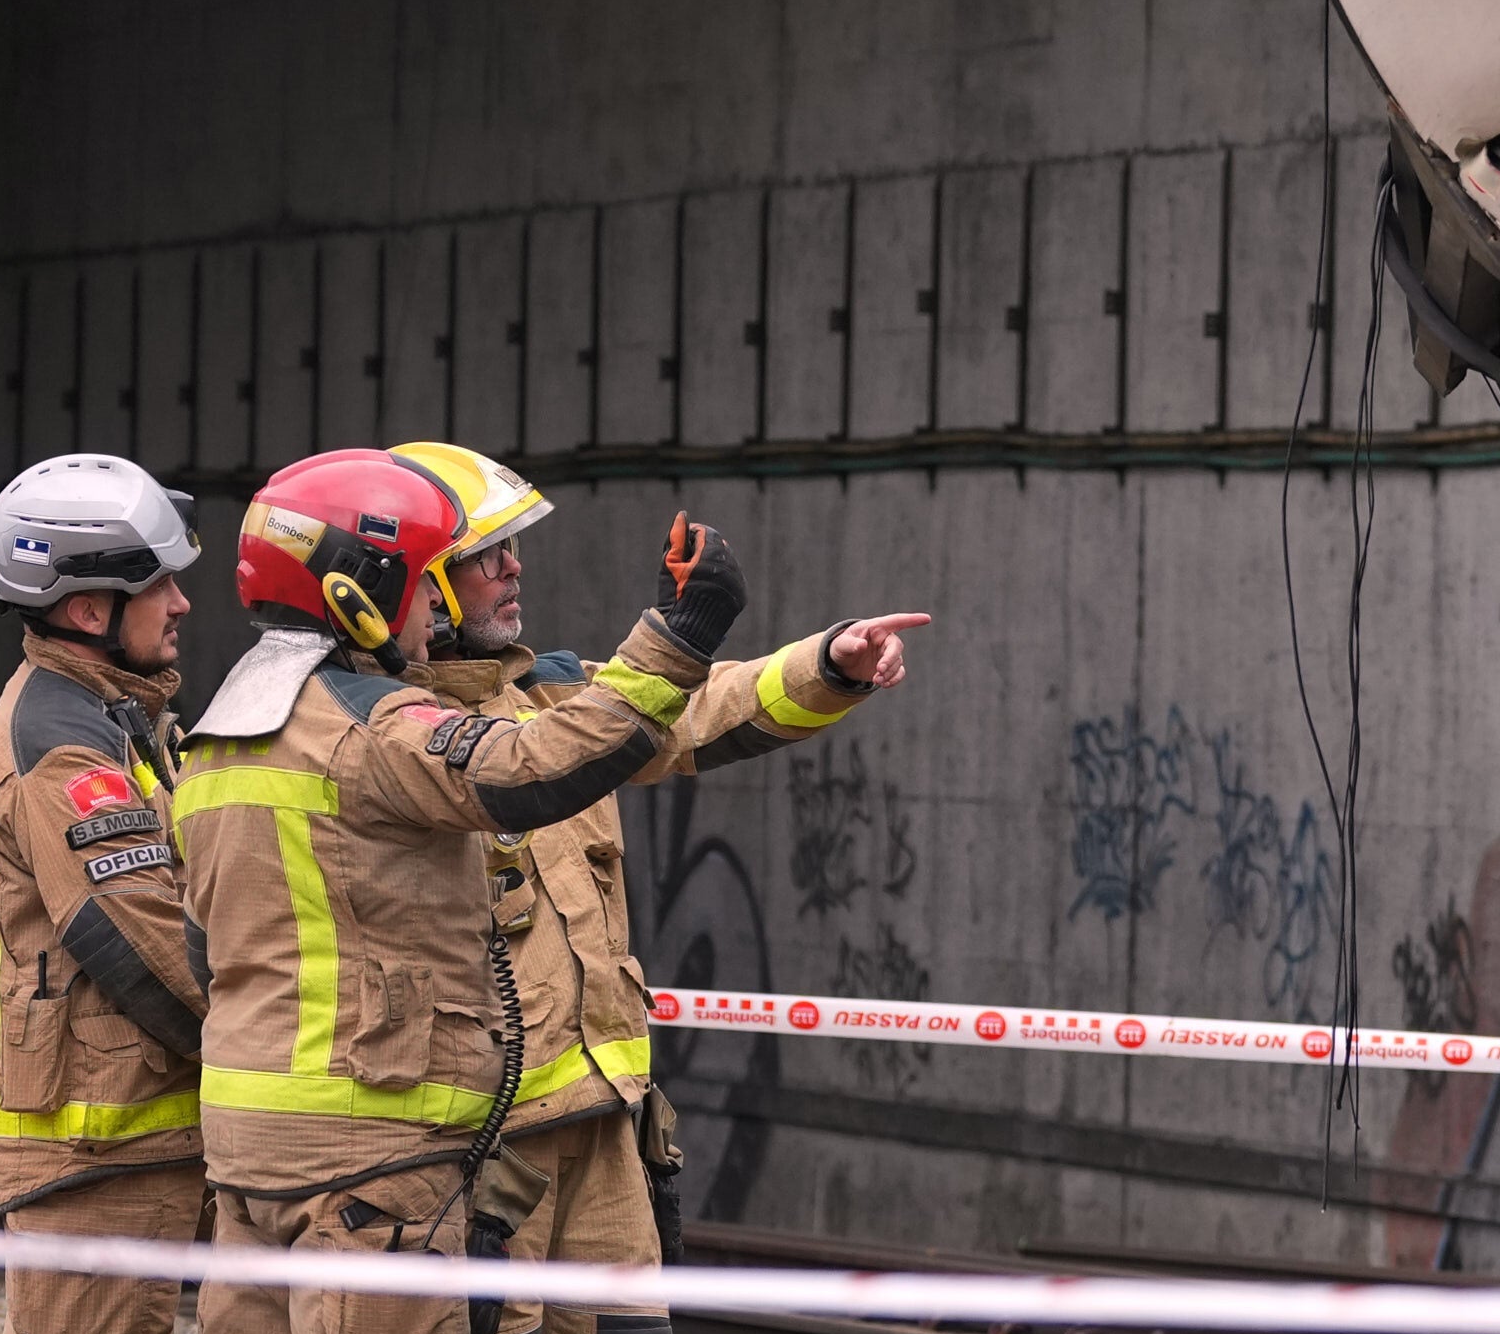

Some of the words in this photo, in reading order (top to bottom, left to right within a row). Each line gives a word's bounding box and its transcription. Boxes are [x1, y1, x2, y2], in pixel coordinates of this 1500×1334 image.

[267, 517, 316, 548] Bombers
[94, 847, 171, 875] OFICIAL
[693, 1011, 777, 1027] bombers
[833, 1010, 921, 1029] PASSEU
[929, 1016, 960, 1031] NO
[1020, 1027, 1101, 1045] bombers
[1159, 1028, 1248, 1047] PASSEU
[1255, 1034, 1288, 1048] NO
